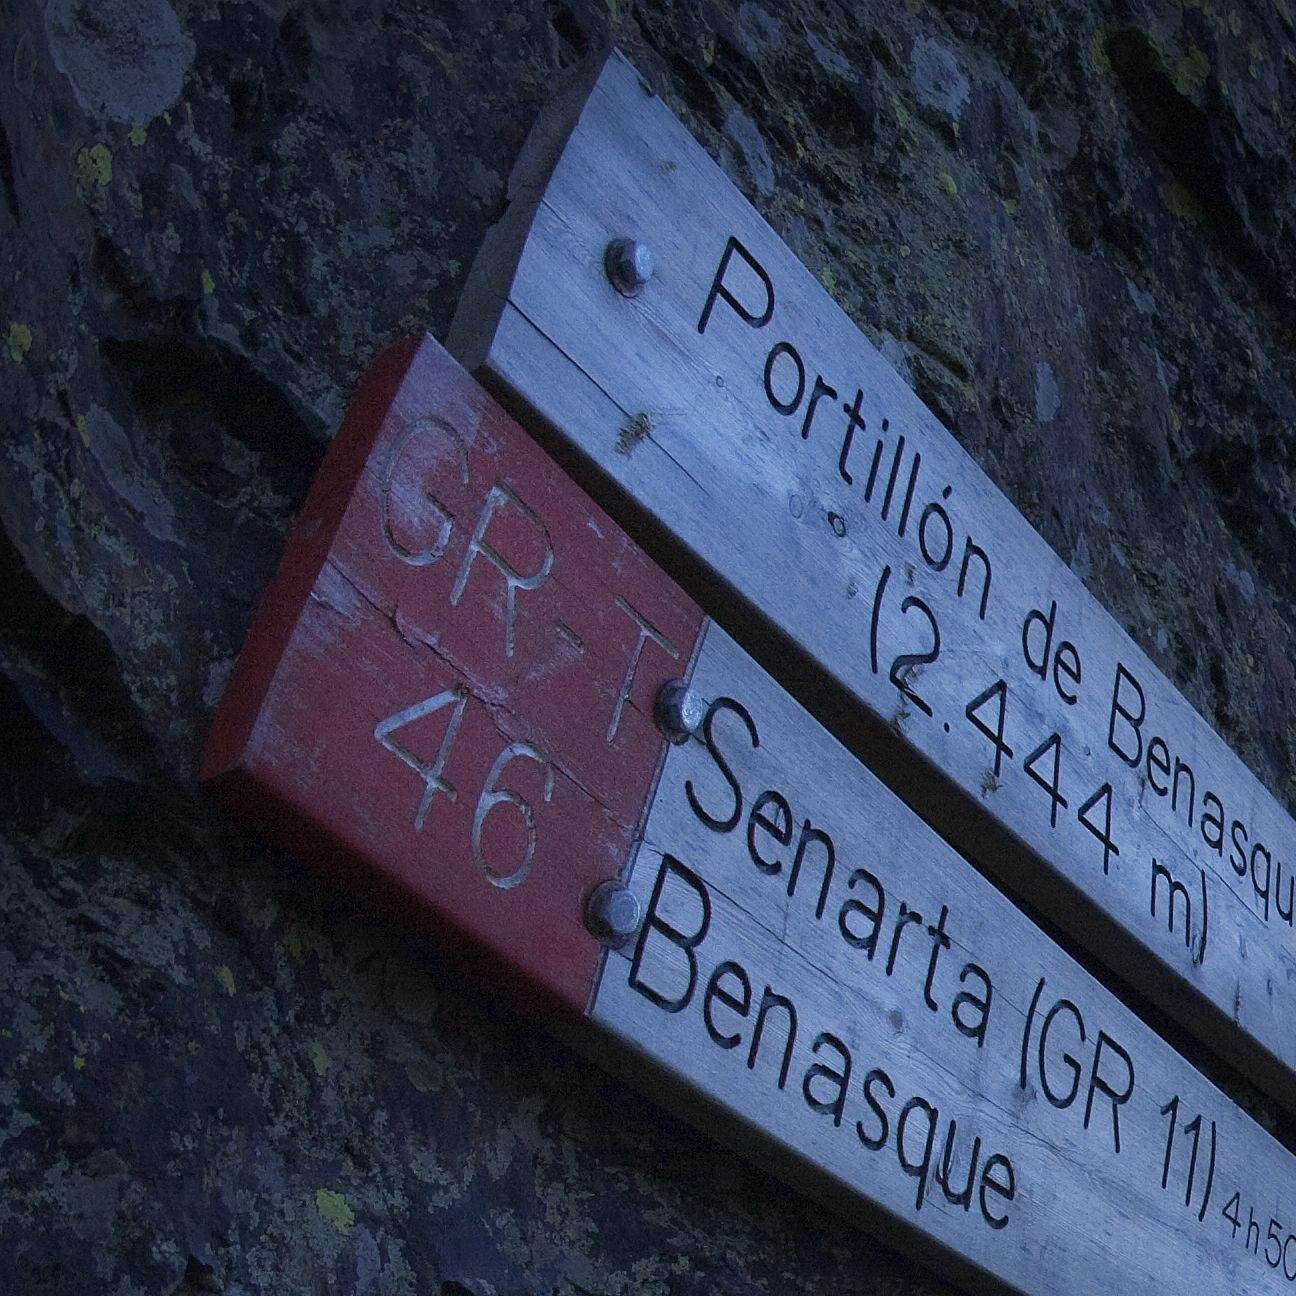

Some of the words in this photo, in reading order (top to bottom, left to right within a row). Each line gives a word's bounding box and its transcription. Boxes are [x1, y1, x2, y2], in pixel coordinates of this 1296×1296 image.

[698, 236, 992, 620] Portillón
[1022, 601, 1083, 706] de
[373, 682, 555, 890] 46
[685, 696, 993, 1048] Senarta
[1019, 977, 1135, 1154] (GR
[1160, 1096, 1217, 1222] 11)
[870, 565, 1120, 875] (2.444
[1150, 856, 1209, 965] m)
[627, 852, 1016, 1230] Benasque
